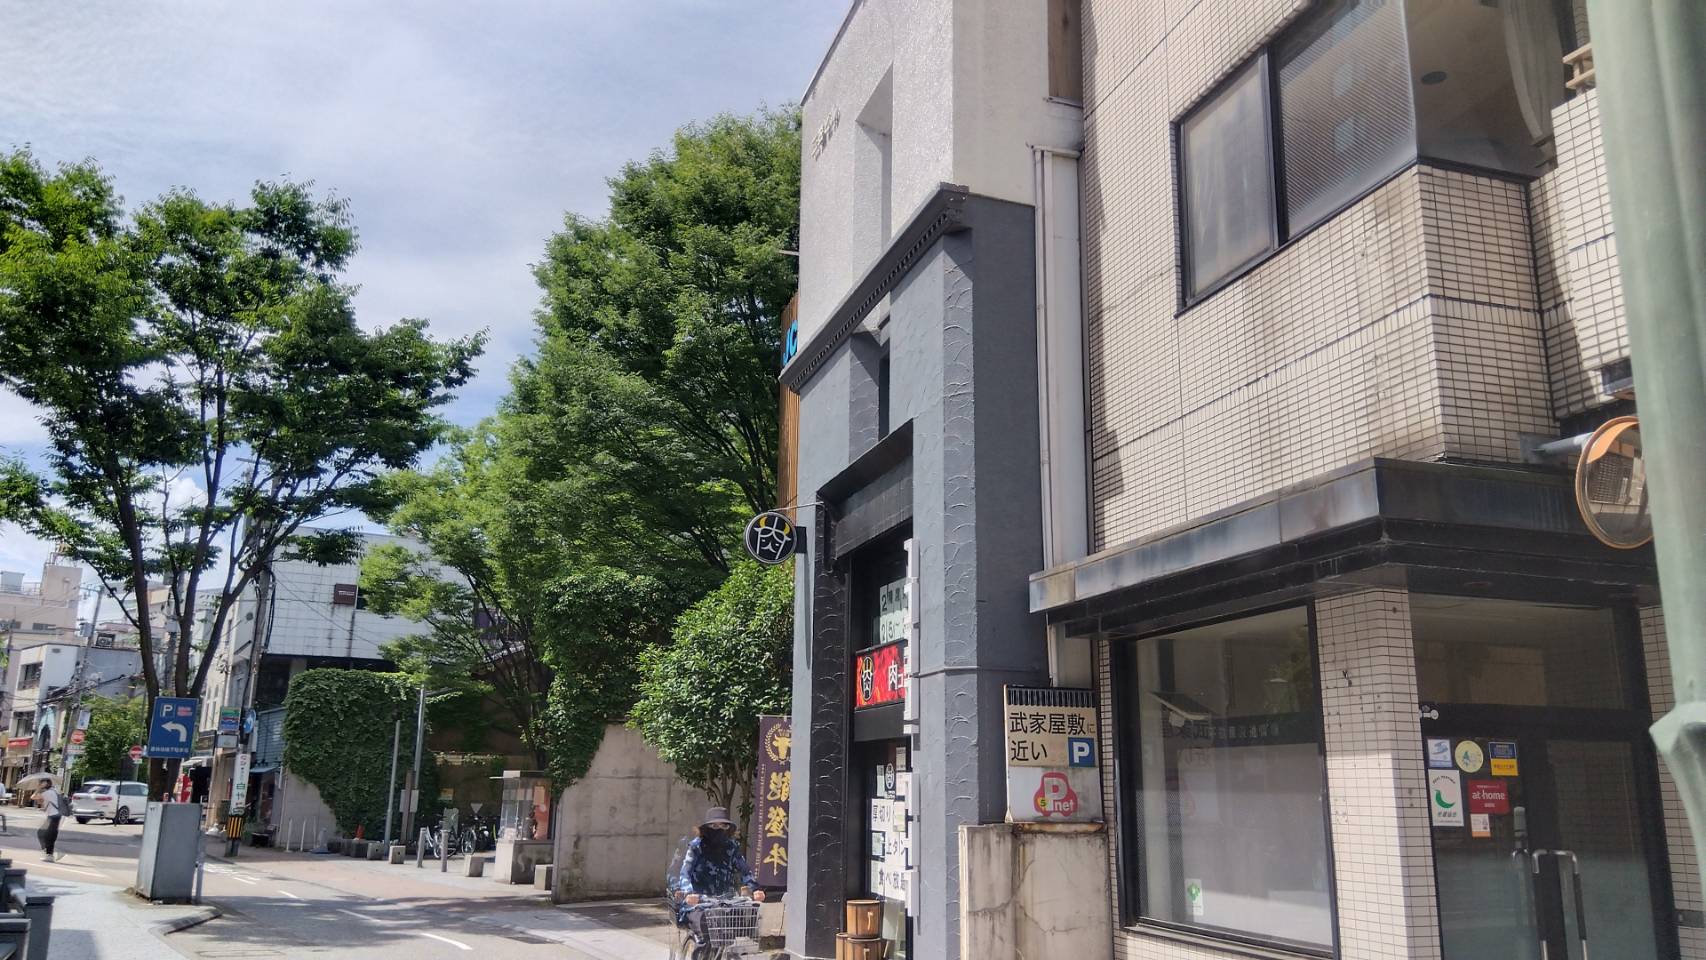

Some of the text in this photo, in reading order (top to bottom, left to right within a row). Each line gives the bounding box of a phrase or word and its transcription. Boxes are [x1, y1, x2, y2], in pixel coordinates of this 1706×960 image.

[162, 704, 173, 717] P
[1009, 711, 1096, 735] 武家屋敷に
[1010, 740, 1047, 761] 近い
[1072, 741, 1090, 763] P
[763, 770, 791, 876] 能登牛
